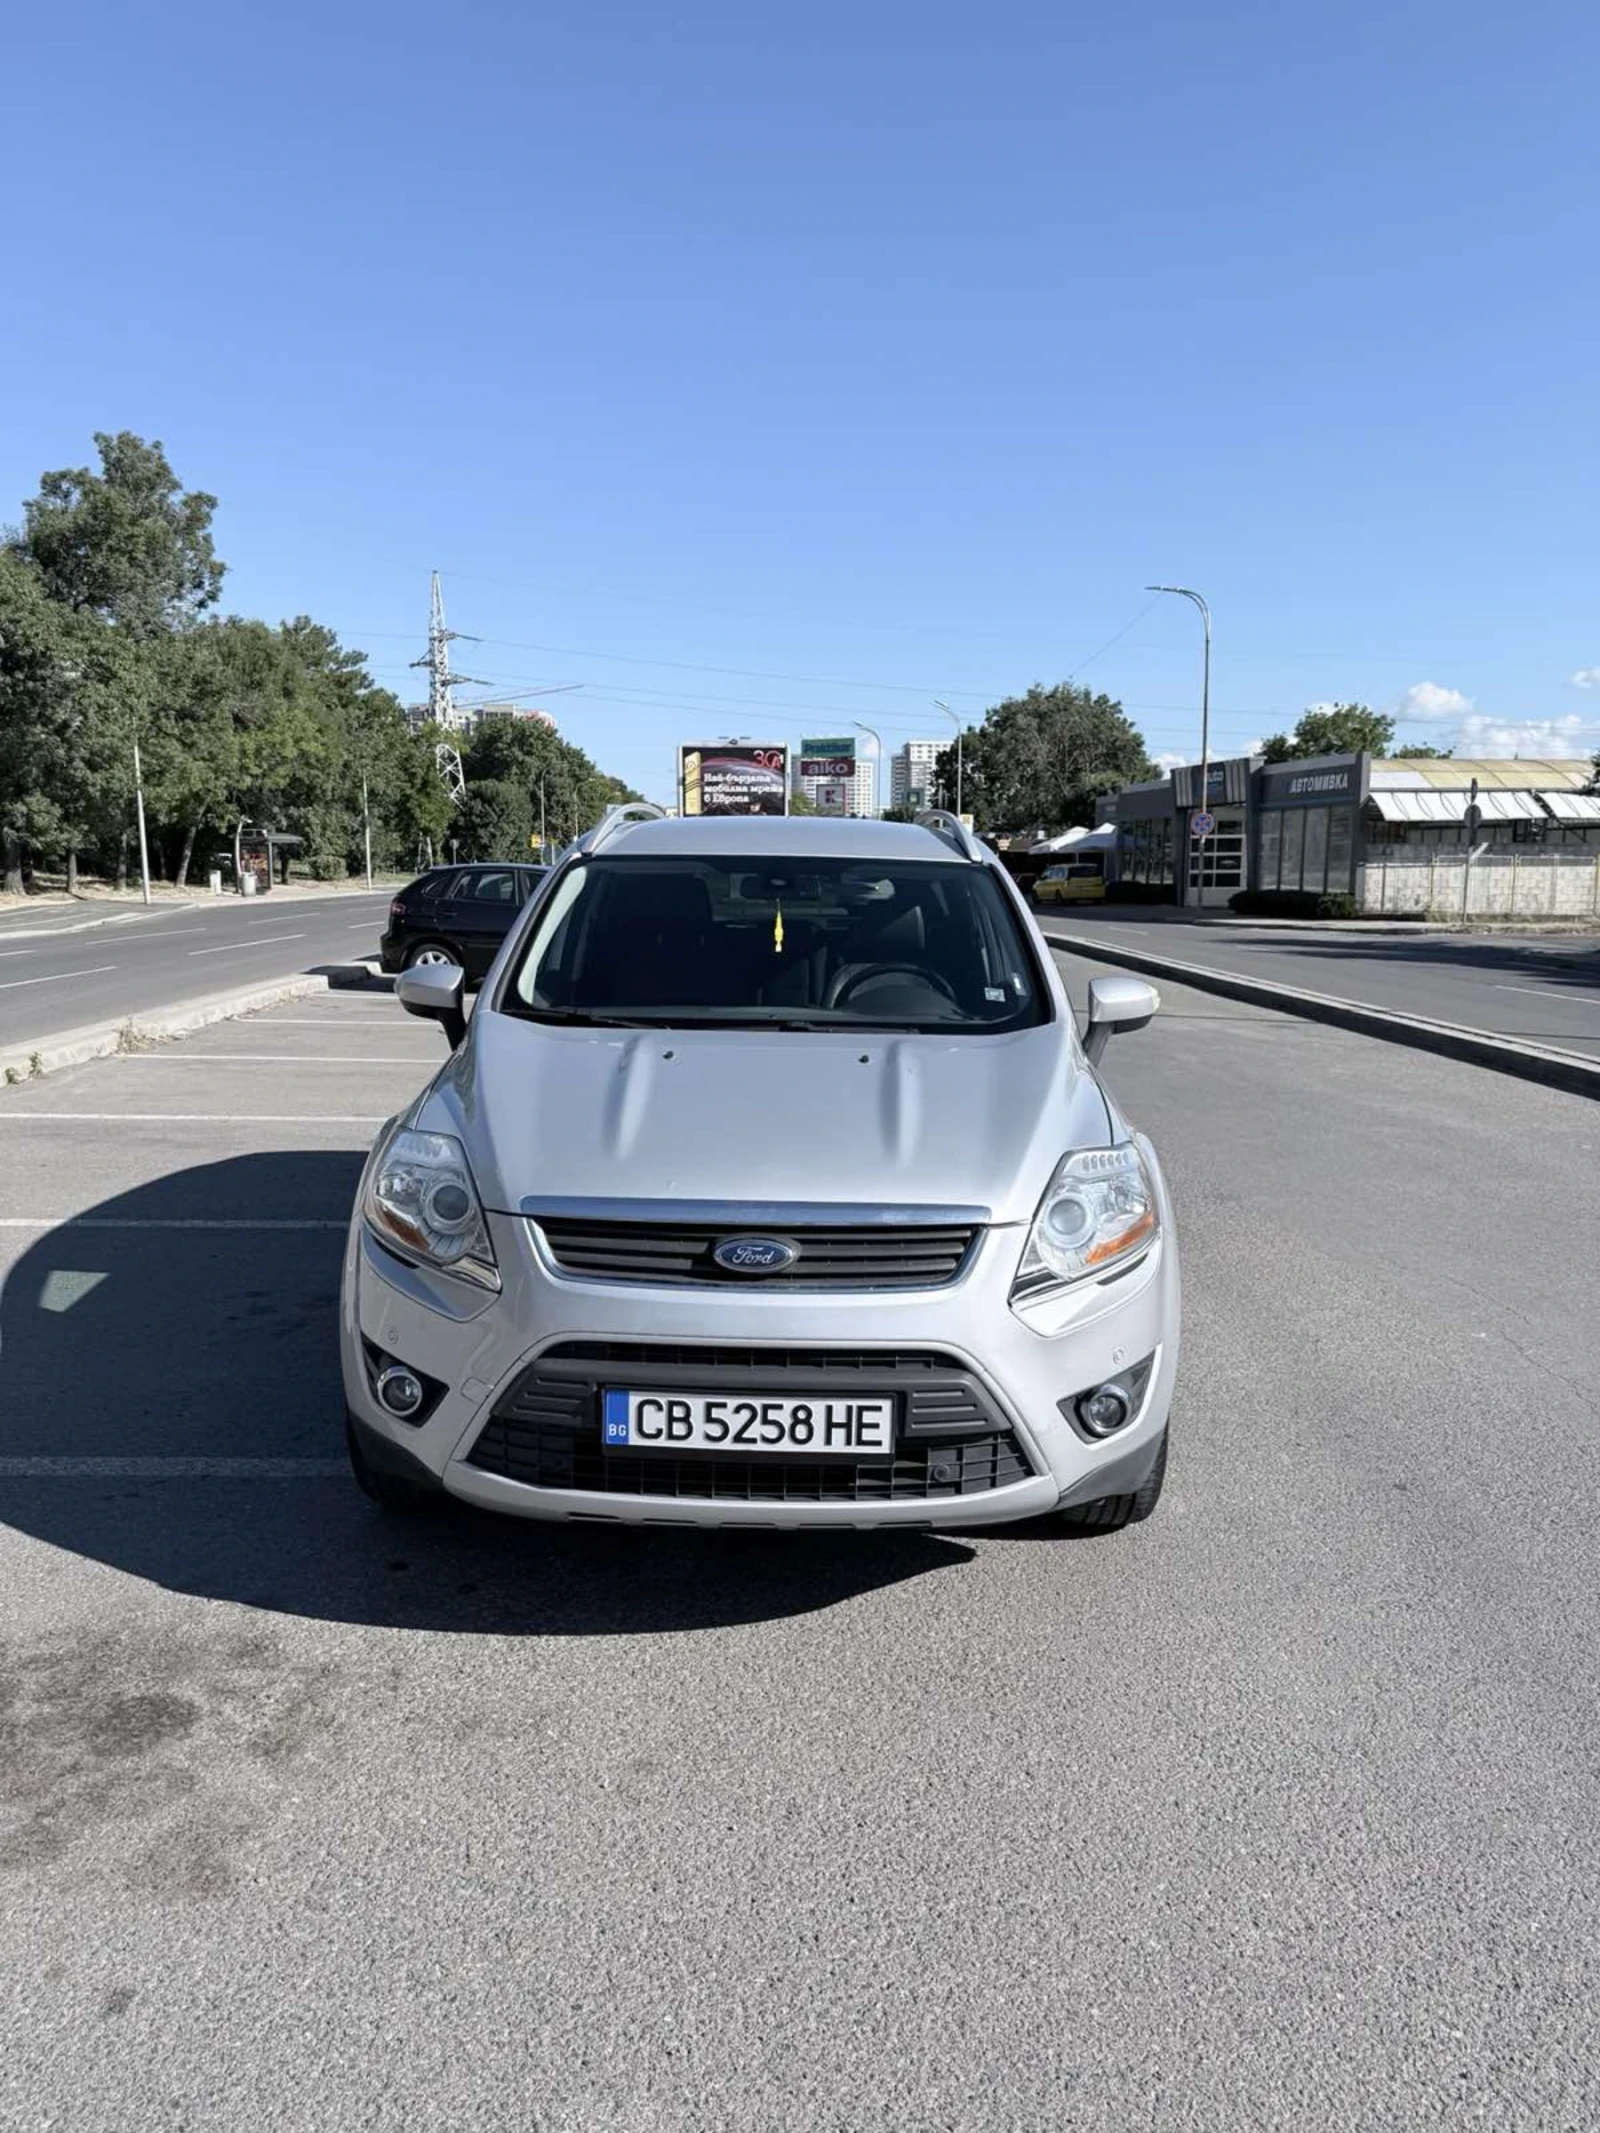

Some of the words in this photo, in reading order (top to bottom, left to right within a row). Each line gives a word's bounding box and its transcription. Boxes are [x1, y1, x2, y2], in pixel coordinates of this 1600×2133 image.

[808, 761, 848, 774] aiko
[703, 773, 771, 784] Най-бързата
[1290, 772, 1349, 794] АВТОМИВКА
[703, 784, 748, 793] мобилна
[750, 784, 784, 794] мрежа
[732, 1245, 775, 1264] Ford
[608, 1423, 627, 1437] BG
[703, 1401, 815, 1445] 5258
